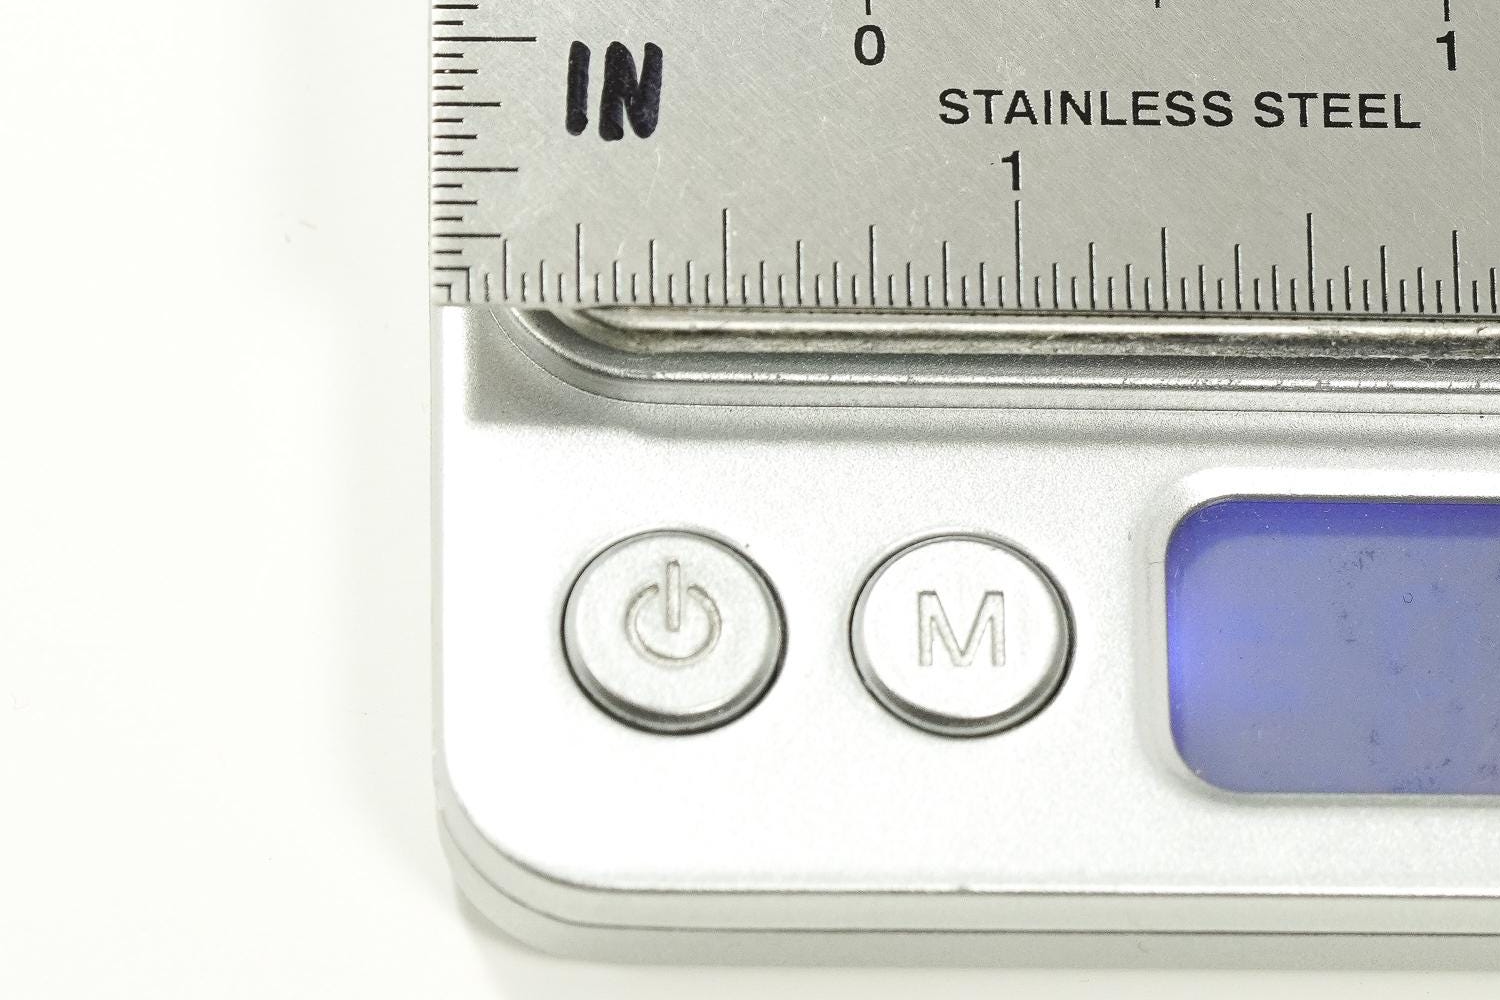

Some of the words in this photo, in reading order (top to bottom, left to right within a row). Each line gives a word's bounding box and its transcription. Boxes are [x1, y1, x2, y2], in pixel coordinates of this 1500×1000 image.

[853, 24, 887, 66] 0
[1435, 30, 1457, 72] 1
[565, 40, 663, 142] IN
[938, 88, 1234, 128] STAINLESS
[1253, 90, 1422, 129] STEEL
[1001, 150, 1021, 191] 1
[917, 590, 1006, 667] M
